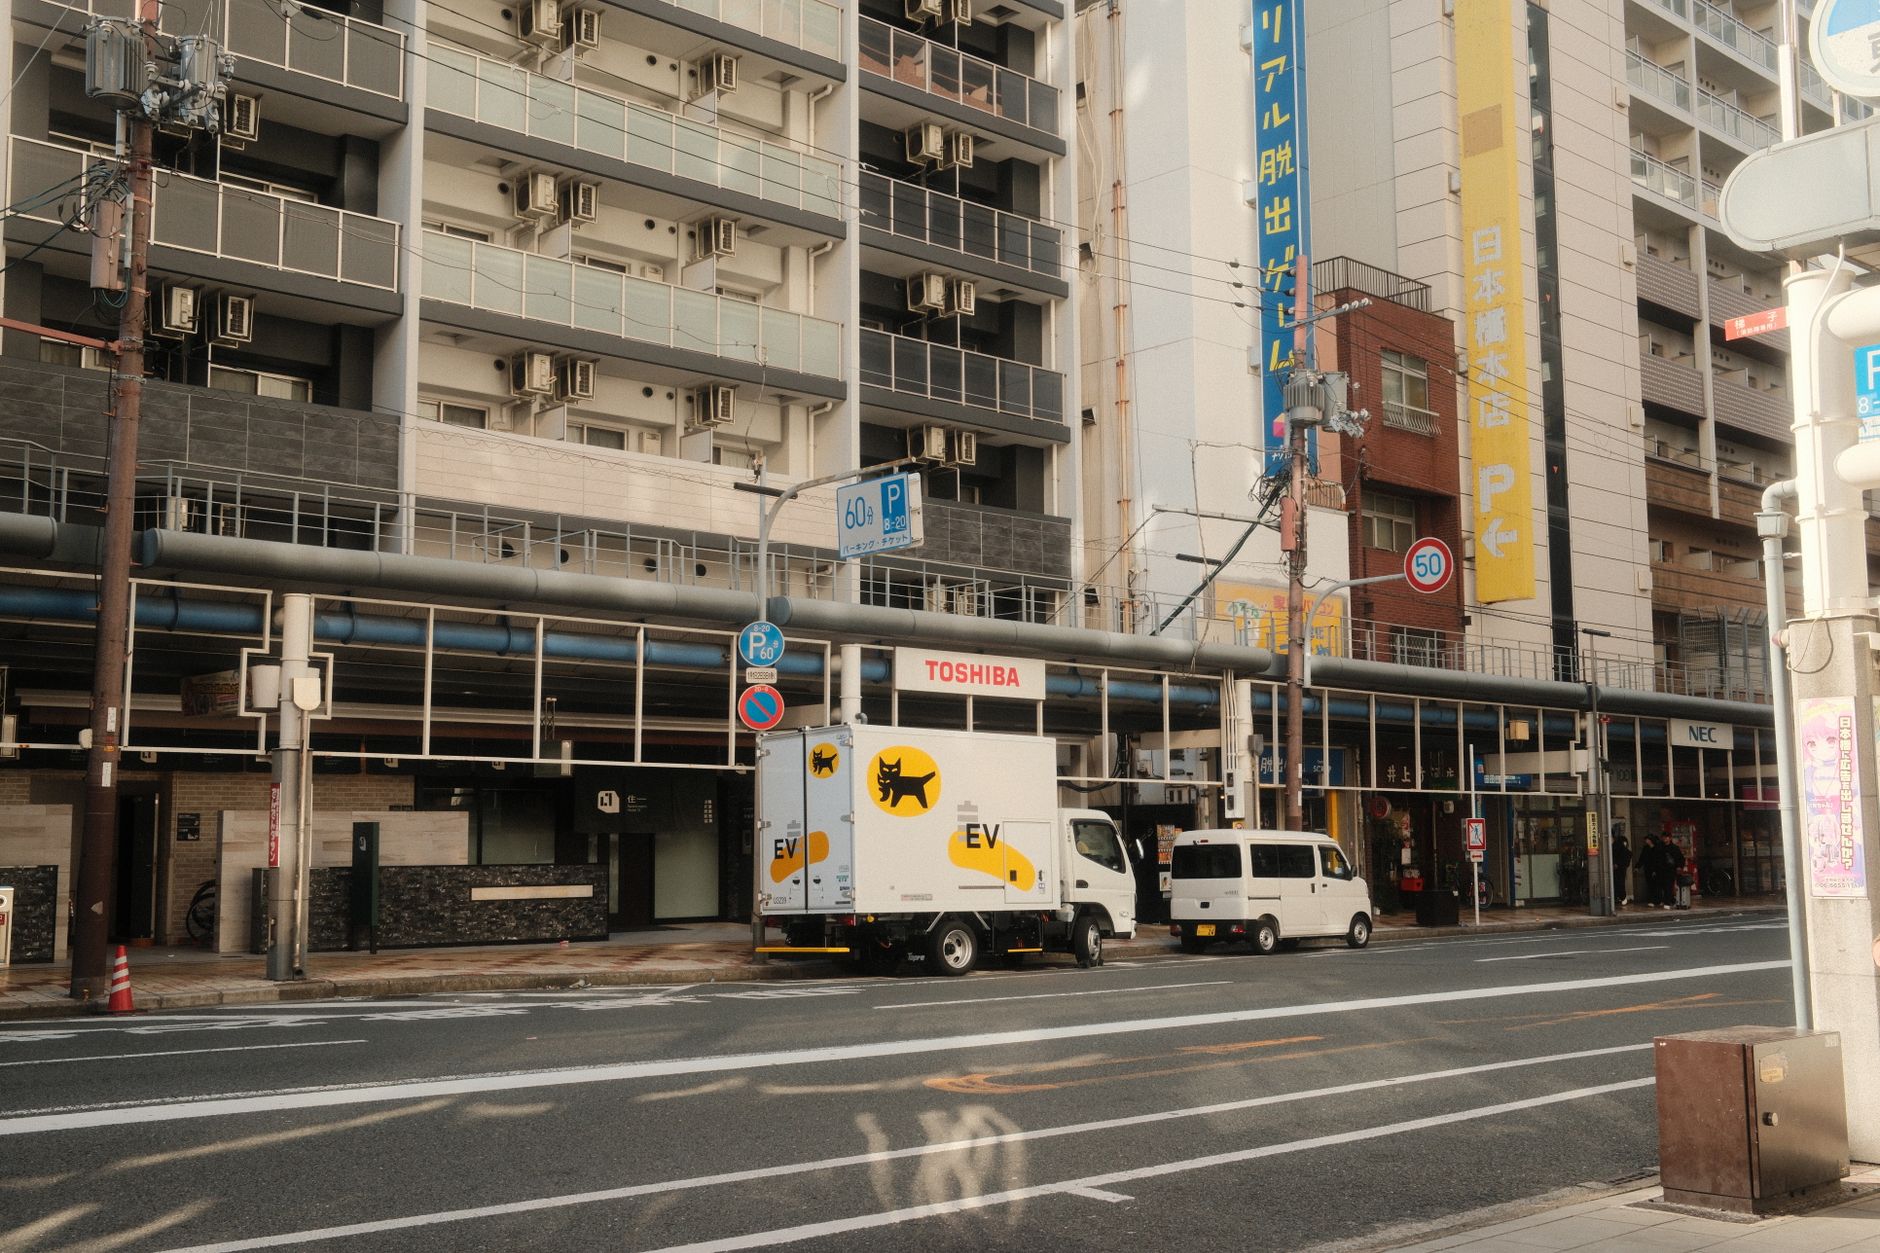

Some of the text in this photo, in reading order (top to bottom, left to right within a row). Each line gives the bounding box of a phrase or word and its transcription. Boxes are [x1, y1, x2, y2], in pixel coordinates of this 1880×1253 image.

[1259, 4, 1296, 371] リアル脱出ゲーム
[1472, 225, 1511, 429] 日本橋本店
[845, 496, 874, 529] 60分
[887, 484, 900, 514] P
[884, 515, 906, 530] 8-20
[1415, 552, 1441, 577] 50
[749, 632, 766, 659] P
[925, 660, 1020, 687] TOSHIBA
[1689, 725, 1718, 743] NEC
[774, 838, 797, 860] EV
[966, 823, 1000, 849] EV
